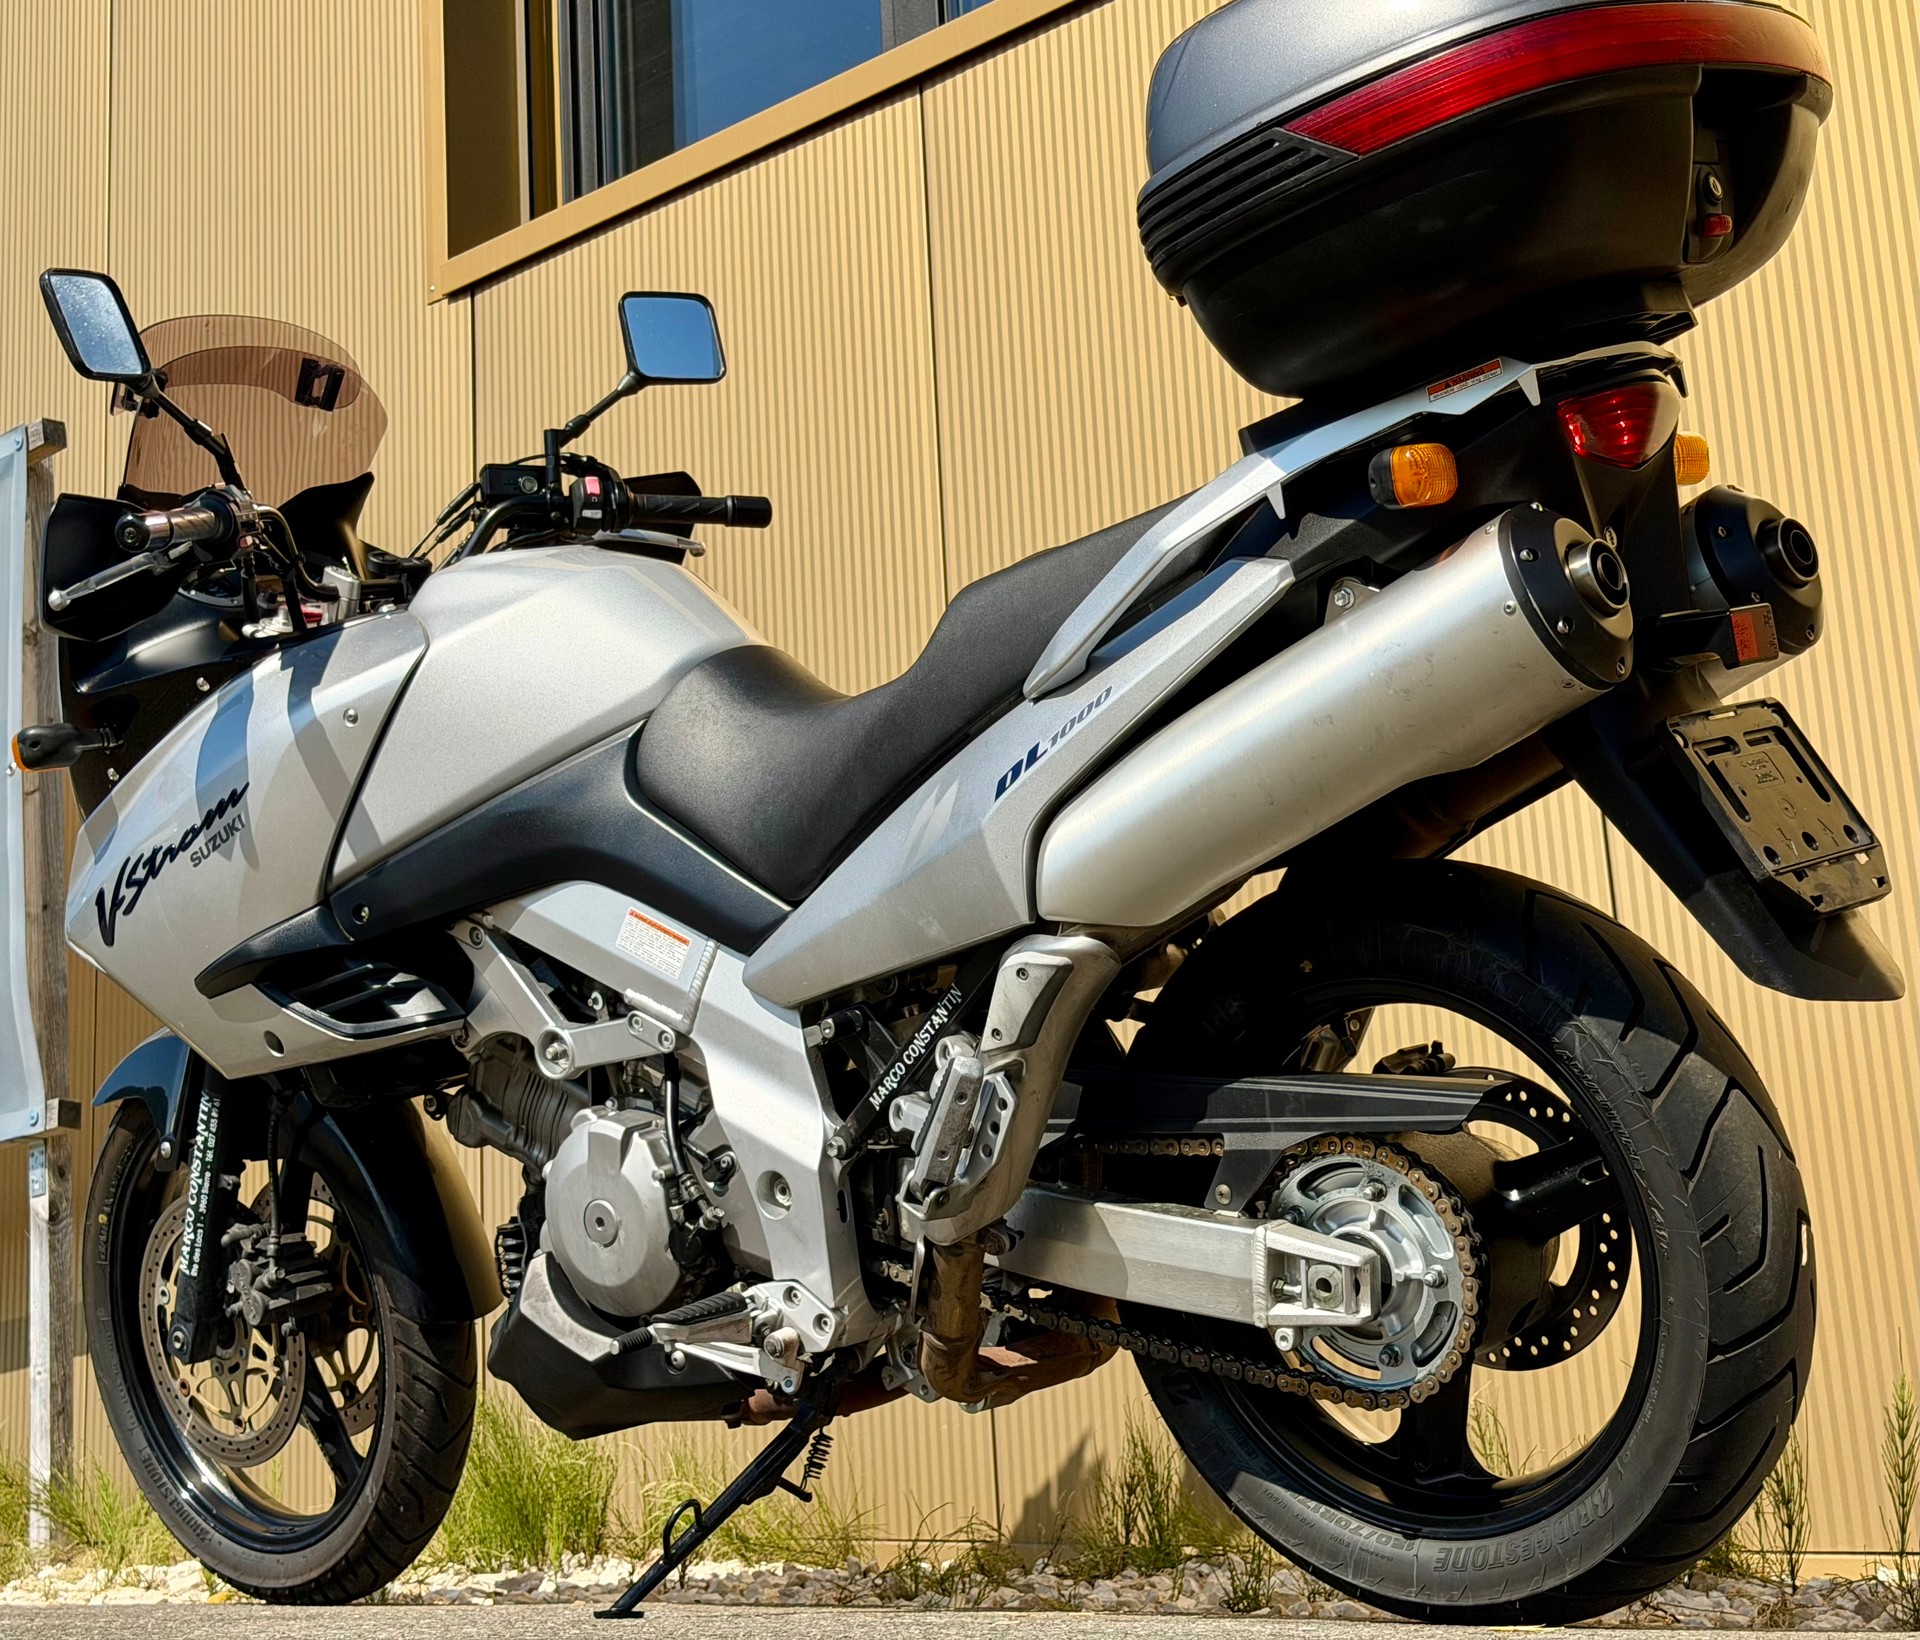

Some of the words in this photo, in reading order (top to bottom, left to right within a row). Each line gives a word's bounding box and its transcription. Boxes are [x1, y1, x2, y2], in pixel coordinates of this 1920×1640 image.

[189, 813, 246, 868] SUZUKI
[868, 1062, 906, 1112] MARCO
[902, 982, 962, 1065] CONSTANTIN
[179, 1209, 195, 1276] MARCO
[189, 1090, 212, 1205] CONSTANTIN
[1433, 1476, 1615, 1572] BRIDGESTONE
